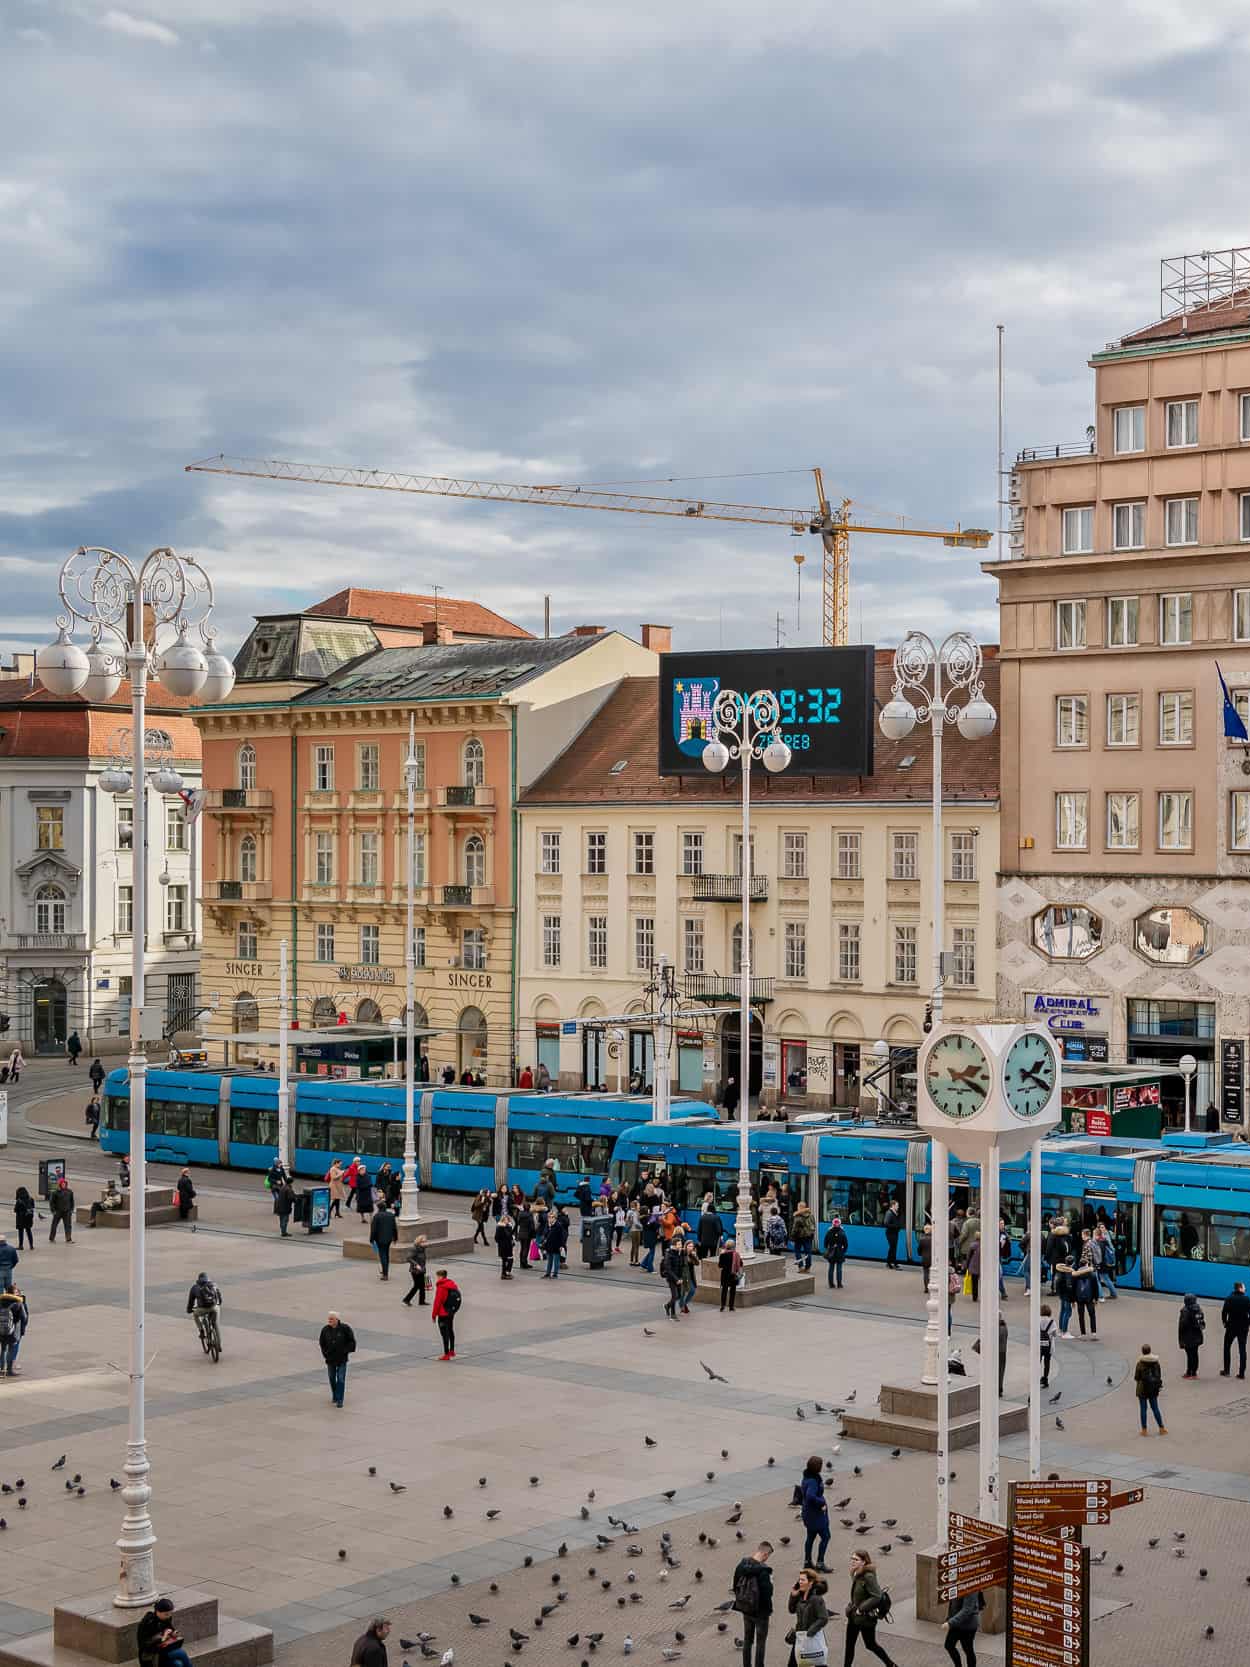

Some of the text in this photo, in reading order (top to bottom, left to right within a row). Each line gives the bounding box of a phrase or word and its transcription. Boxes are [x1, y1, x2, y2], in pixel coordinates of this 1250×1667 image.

[225, 961, 263, 976] SINGER
[448, 973, 492, 989] SINGER
[1034, 995, 1098, 1012] ADMIRAL
